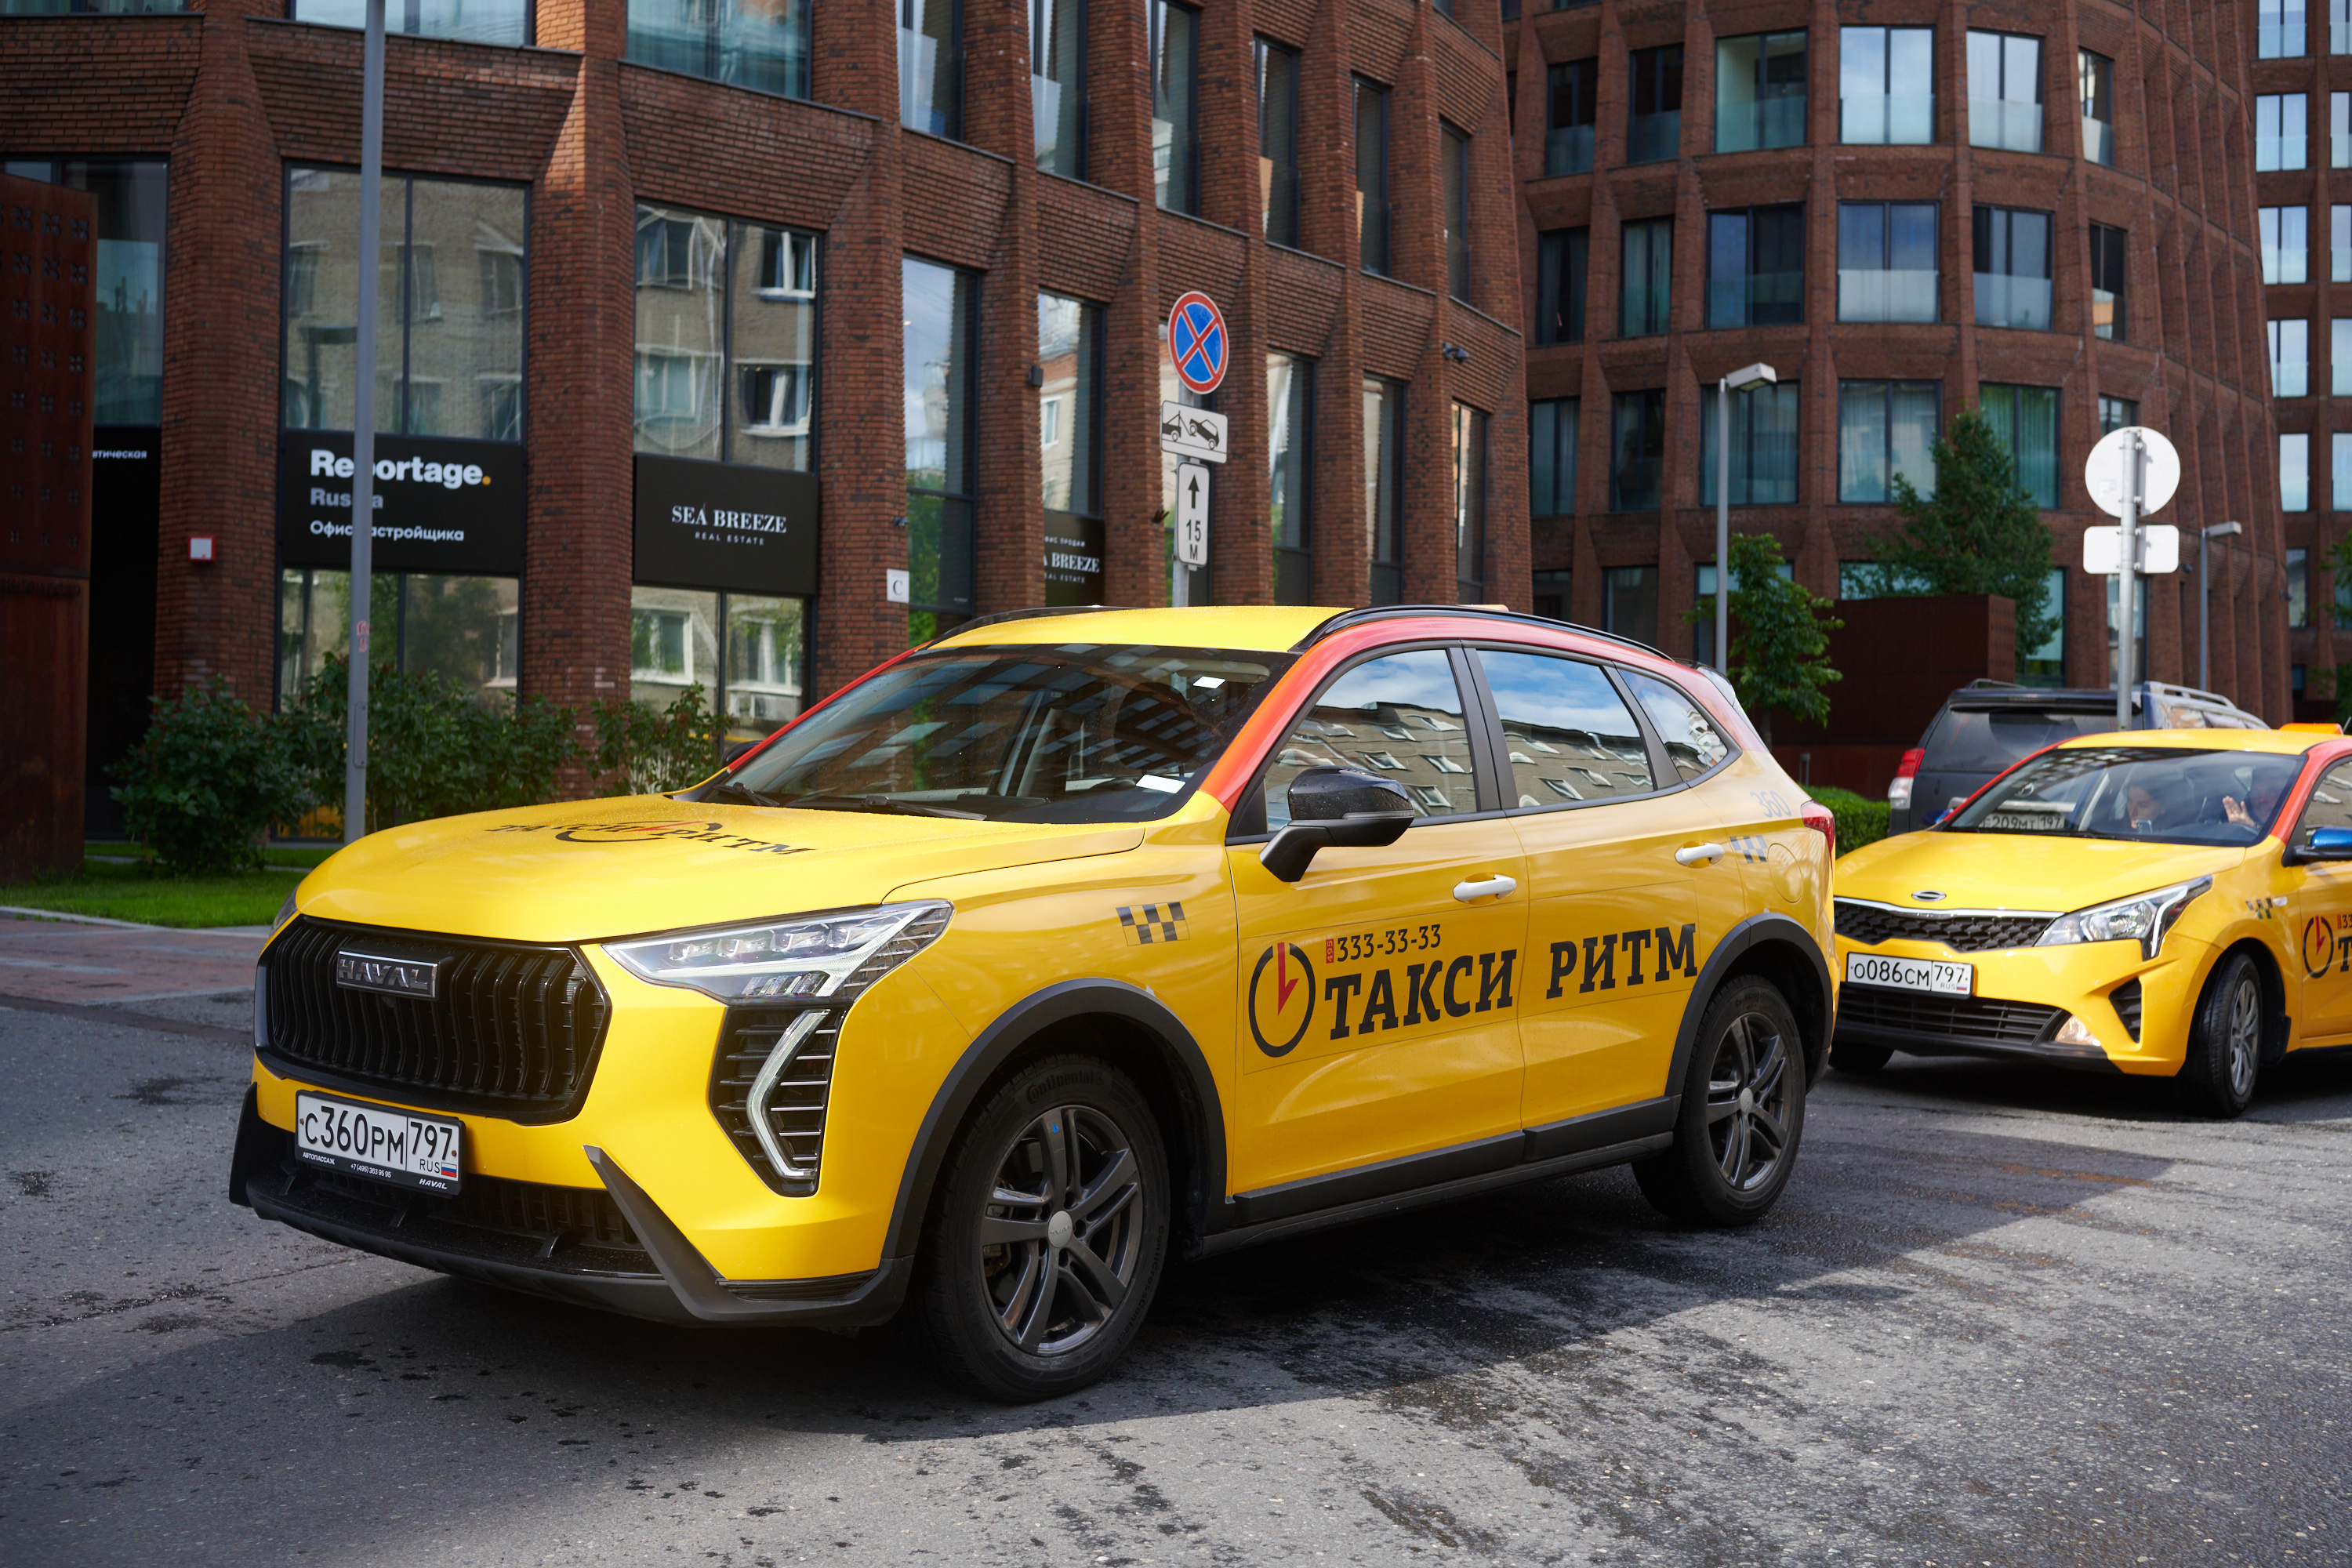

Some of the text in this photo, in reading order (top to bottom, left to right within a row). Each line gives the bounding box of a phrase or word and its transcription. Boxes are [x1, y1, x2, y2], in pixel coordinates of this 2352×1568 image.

[310, 449, 492, 489] Reortage.
[310, 487, 383, 509] Rusa
[672, 503, 786, 534] SEA BREEZE
[370, 524, 464, 542] астройщика
[695, 531, 764, 546] REAL ESTATE
[1186, 519, 1201, 542] 15
[1051, 552, 1100, 573] BREEZE
[1189, 543, 1198, 561] М
[892, 579, 903, 596] С
[1749, 790, 1791, 818] 360
[1338, 924, 1441, 962] 333-33-33
[338, 959, 428, 990] HAVAL
[1325, 924, 1698, 1040] ТАКСИ РИТМ
[1854, 960, 1965, 986] О086СМ 797
[1029, 1069, 1093, 1102] Continental
[305, 1105, 452, 1165] С360РМ 797
[302, 1152, 335, 1165] АВТОПАССАЖ
[356, 1163, 369, 1174] (495)
[369, 1167, 379, 1175] 363
[419, 1159, 441, 1174] RUS
[419, 1178, 448, 1189] HAVAL
